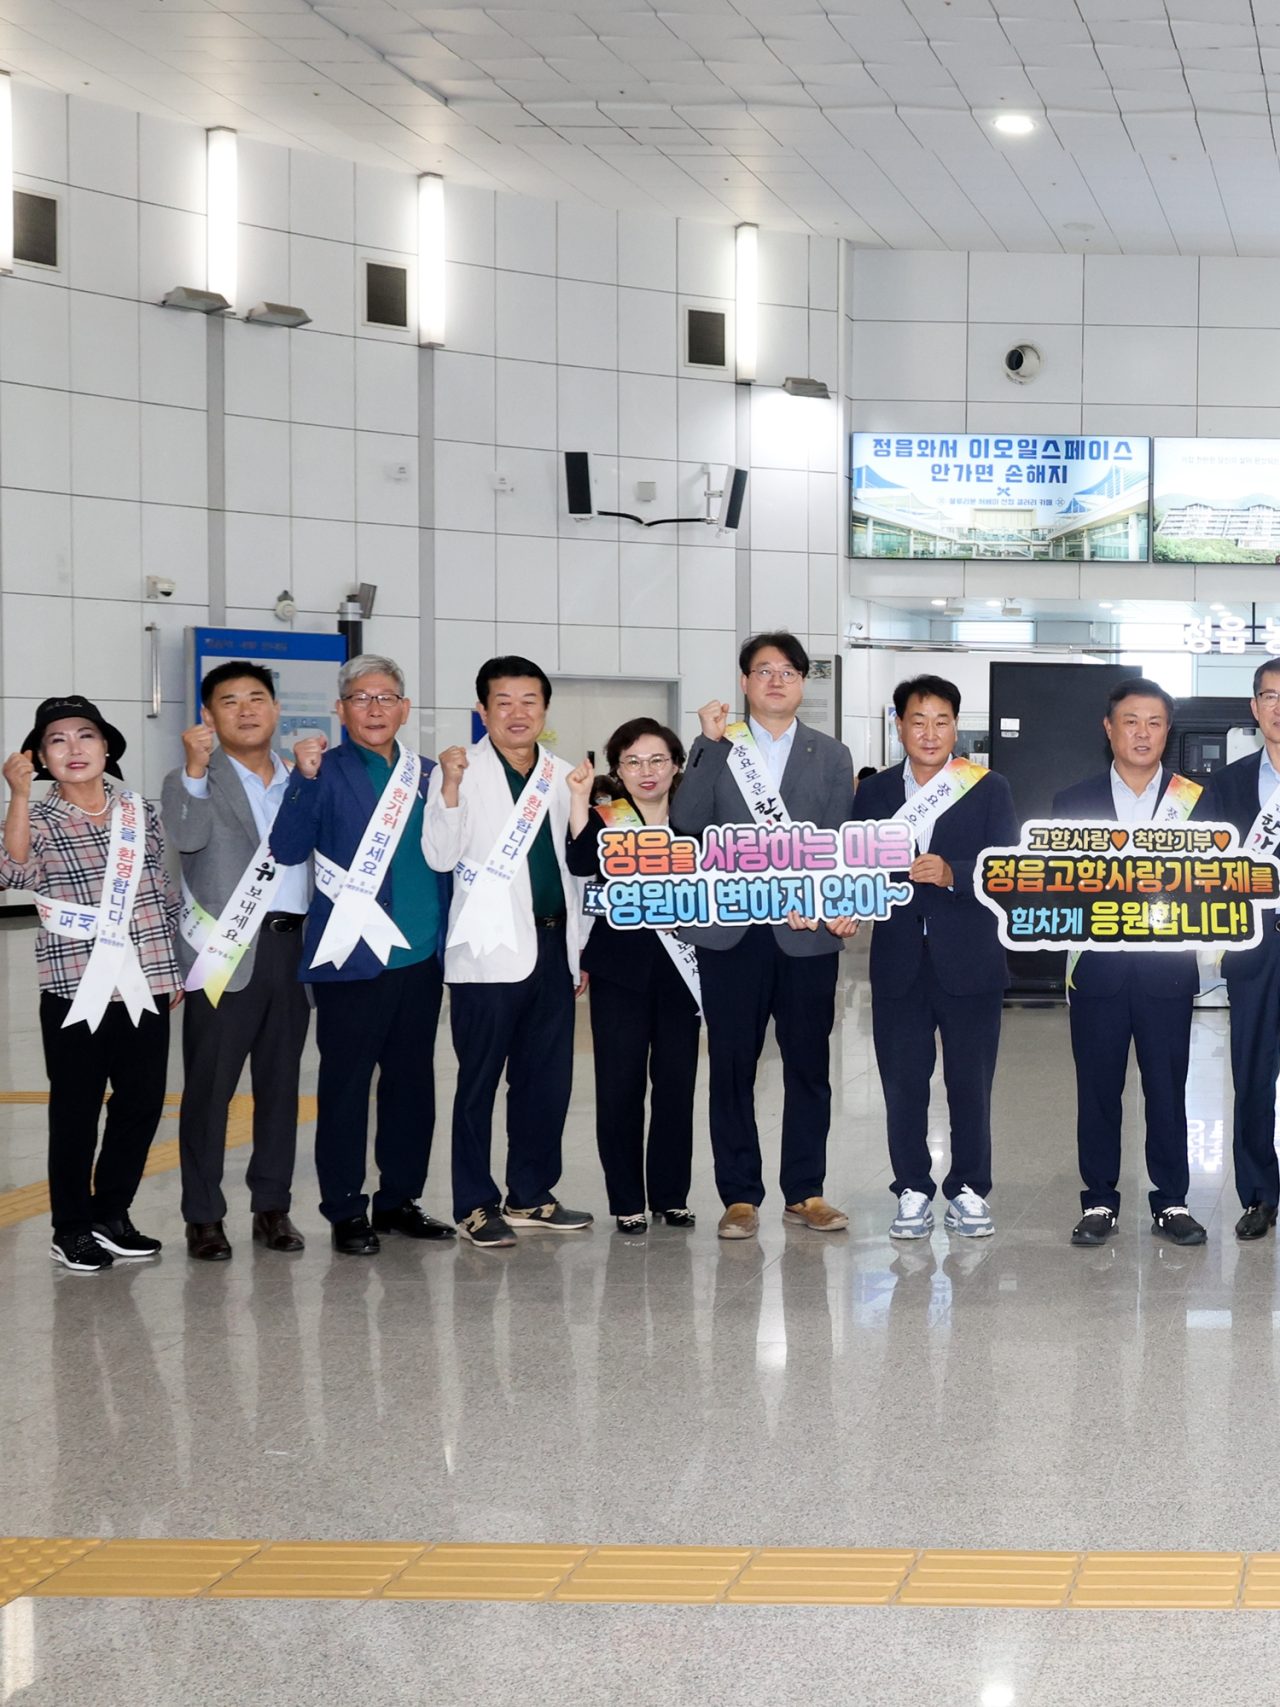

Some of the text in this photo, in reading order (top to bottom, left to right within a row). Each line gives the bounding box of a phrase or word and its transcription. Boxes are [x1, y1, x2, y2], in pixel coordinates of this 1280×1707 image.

[872, 438, 1134, 461] 정읍와서 이오일스페이스
[931, 464, 1068, 484] 안가면 손해지
[1186, 615, 1251, 656] 정읍
[733, 744, 783, 827] 풍요로운 한가
[382, 787, 409, 830] 한가위
[502, 794, 543, 861] 환영합니다
[358, 831, 391, 877] 되세요
[602, 823, 912, 875] 정읍을 사랑하는 마음
[1029, 829, 1213, 852] 고향사랑 착한기부
[108, 847, 137, 926] 환영합니다
[986, 858, 1274, 894] 정읍고향사랑기부제를
[59, 910, 97, 932] 되세
[609, 878, 708, 925] 영원히
[716, 876, 815, 921] 변하지
[1011, 901, 1249, 936] 힘차게 응원합니다!
